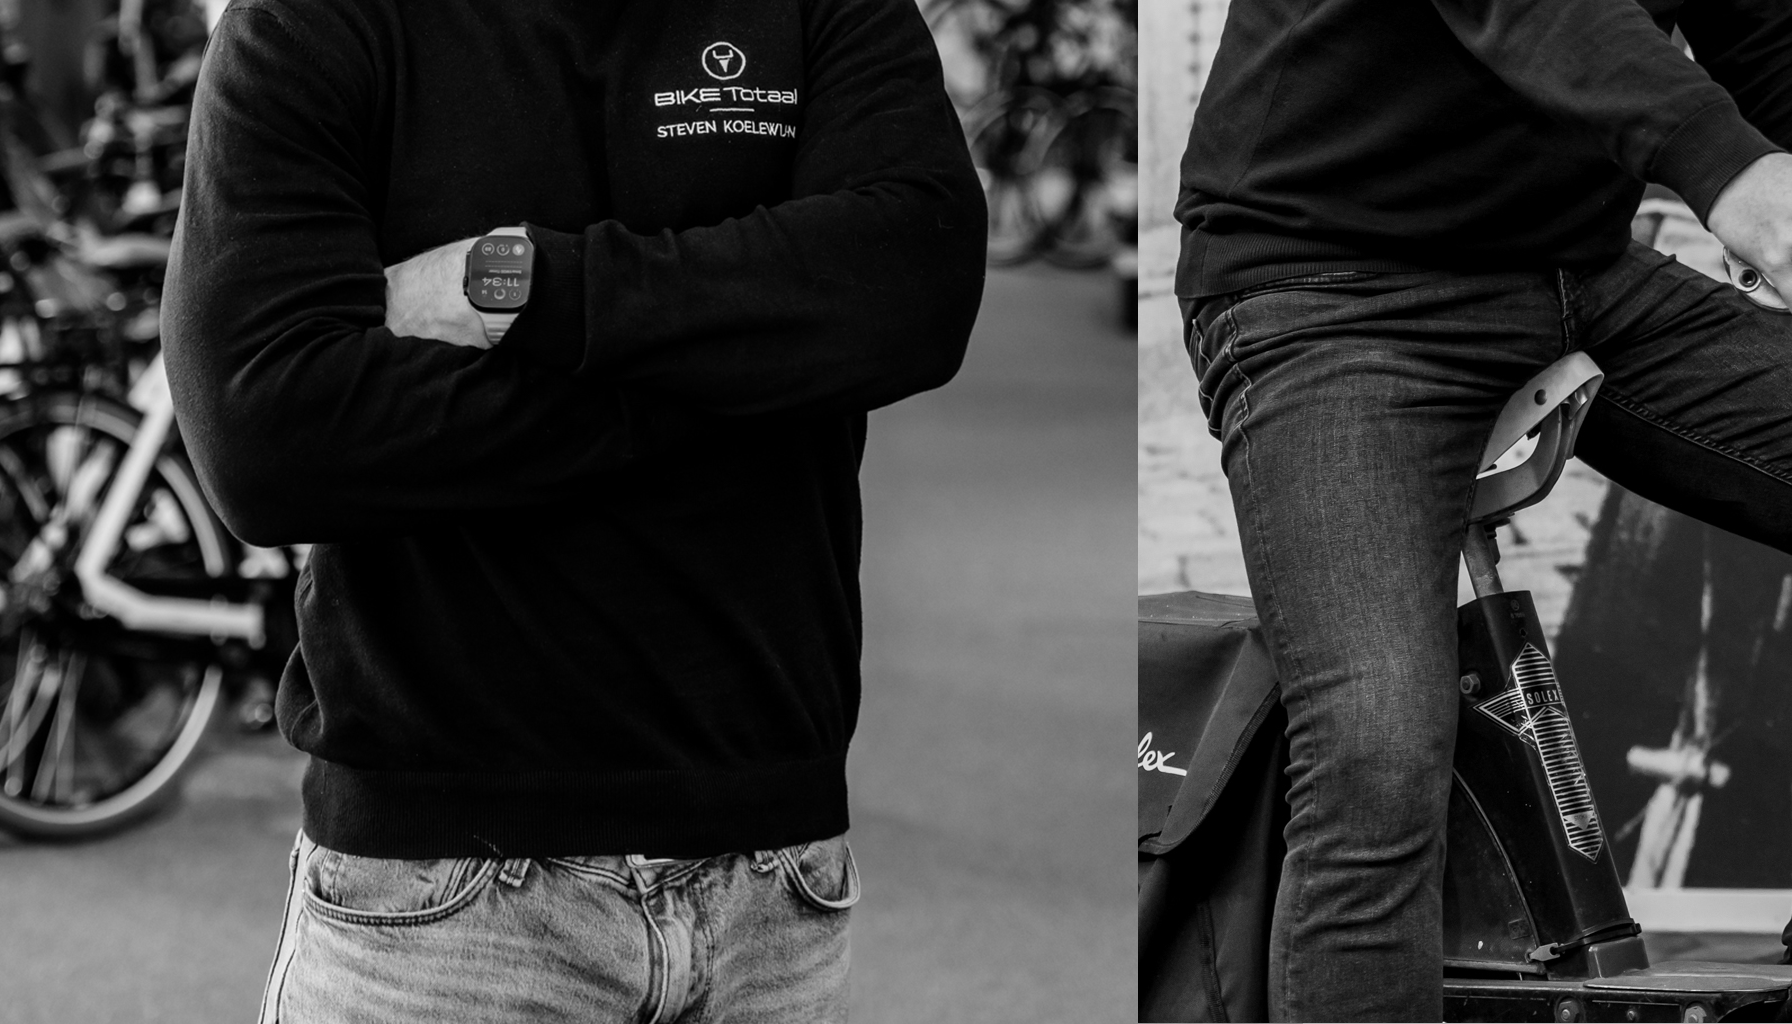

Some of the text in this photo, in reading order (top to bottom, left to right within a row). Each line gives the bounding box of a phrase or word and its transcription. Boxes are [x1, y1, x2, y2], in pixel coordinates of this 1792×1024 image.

[654, 86, 798, 107] BIKE Totaal
[657, 120, 717, 138] STEVEN
[481, 277, 520, 287] 11:34
[1526, 689, 1560, 705] SOLEX
